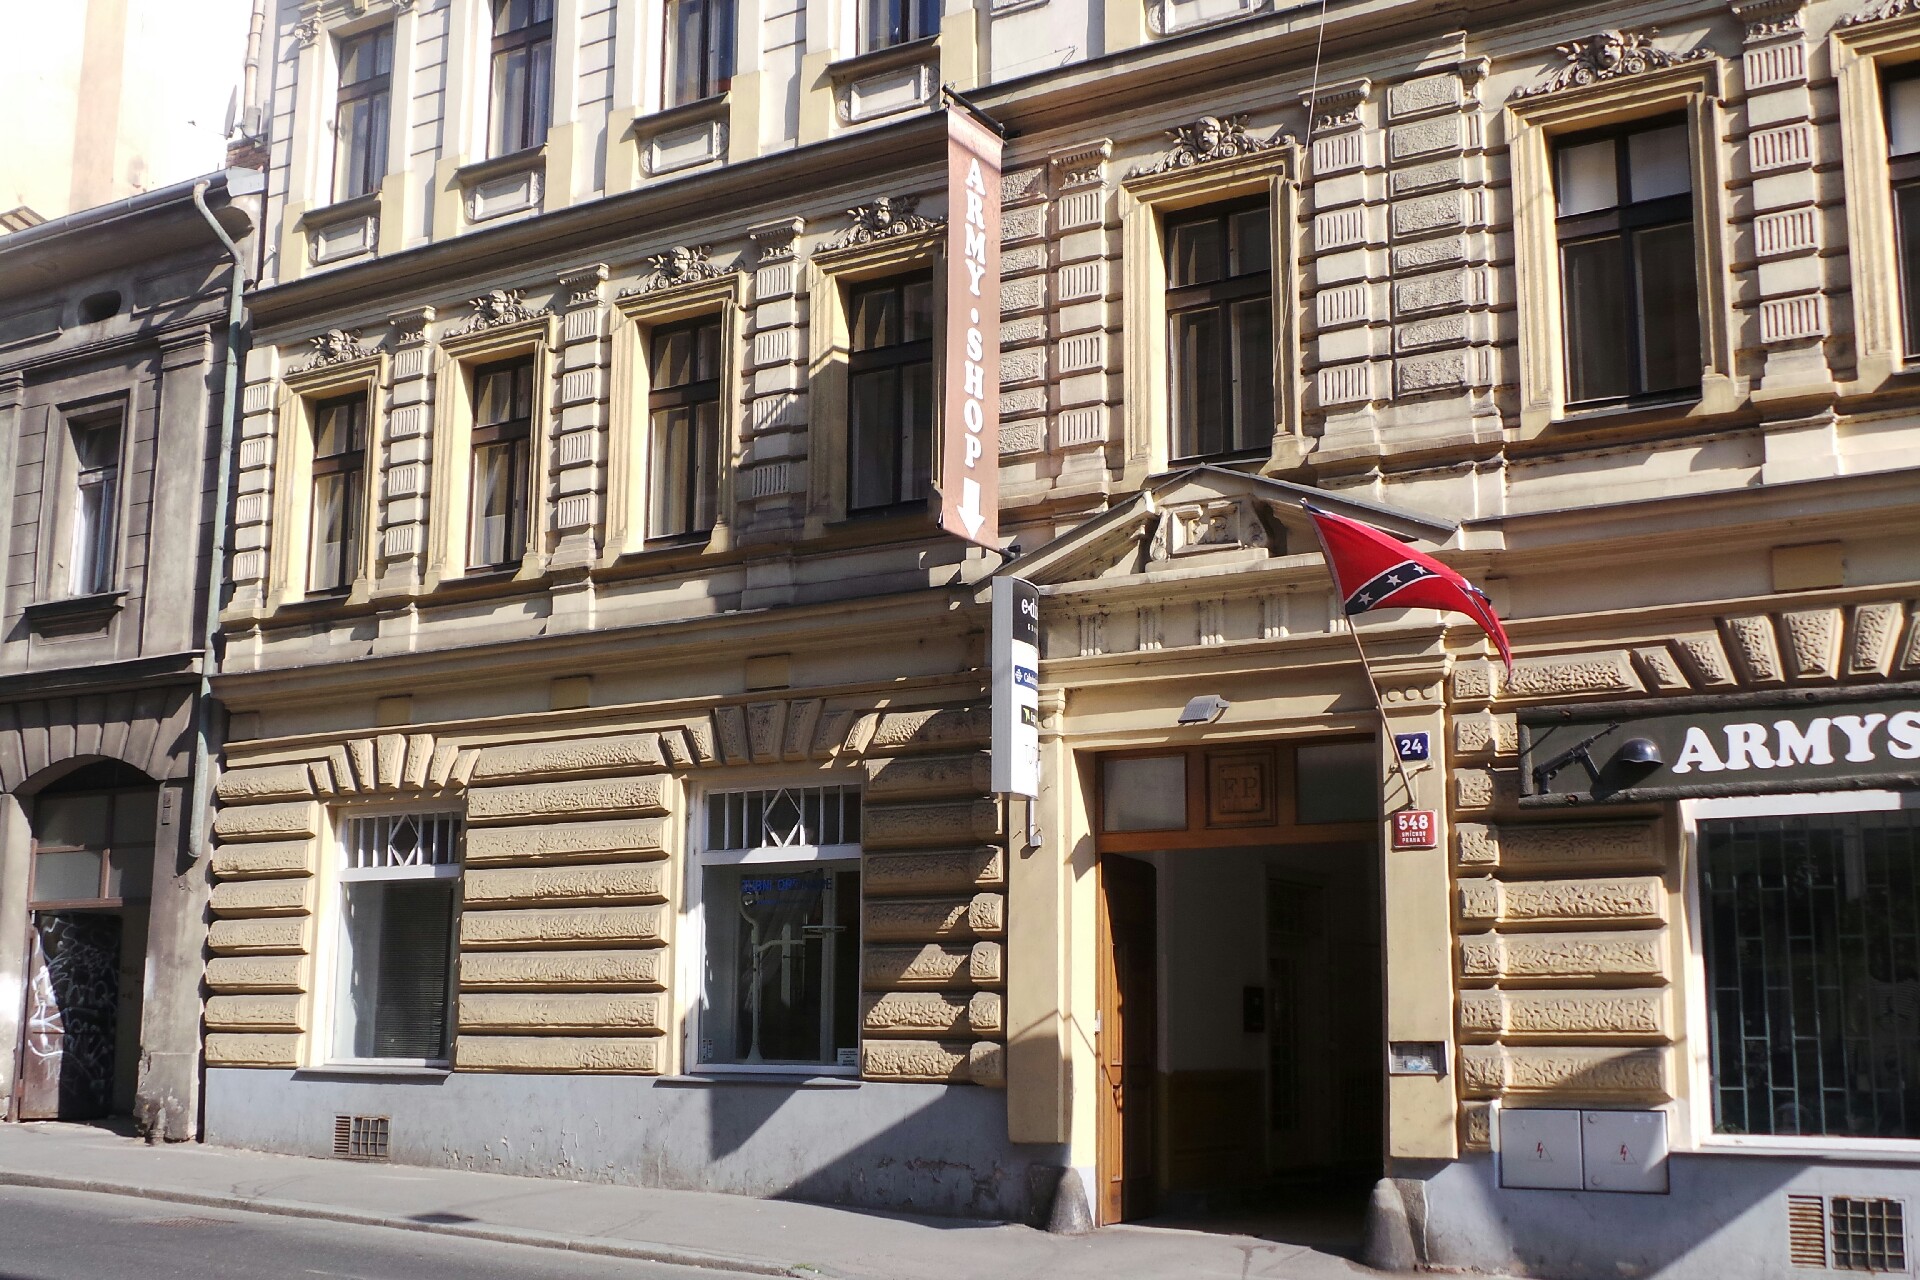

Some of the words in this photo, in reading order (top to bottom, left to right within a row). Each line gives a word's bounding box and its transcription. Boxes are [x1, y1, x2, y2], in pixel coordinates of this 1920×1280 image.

[965, 157, 986, 296] ARMY
[963, 327, 984, 468] SHOP
[1401, 738, 1423, 755] 24
[1398, 814, 1429, 831] 548
